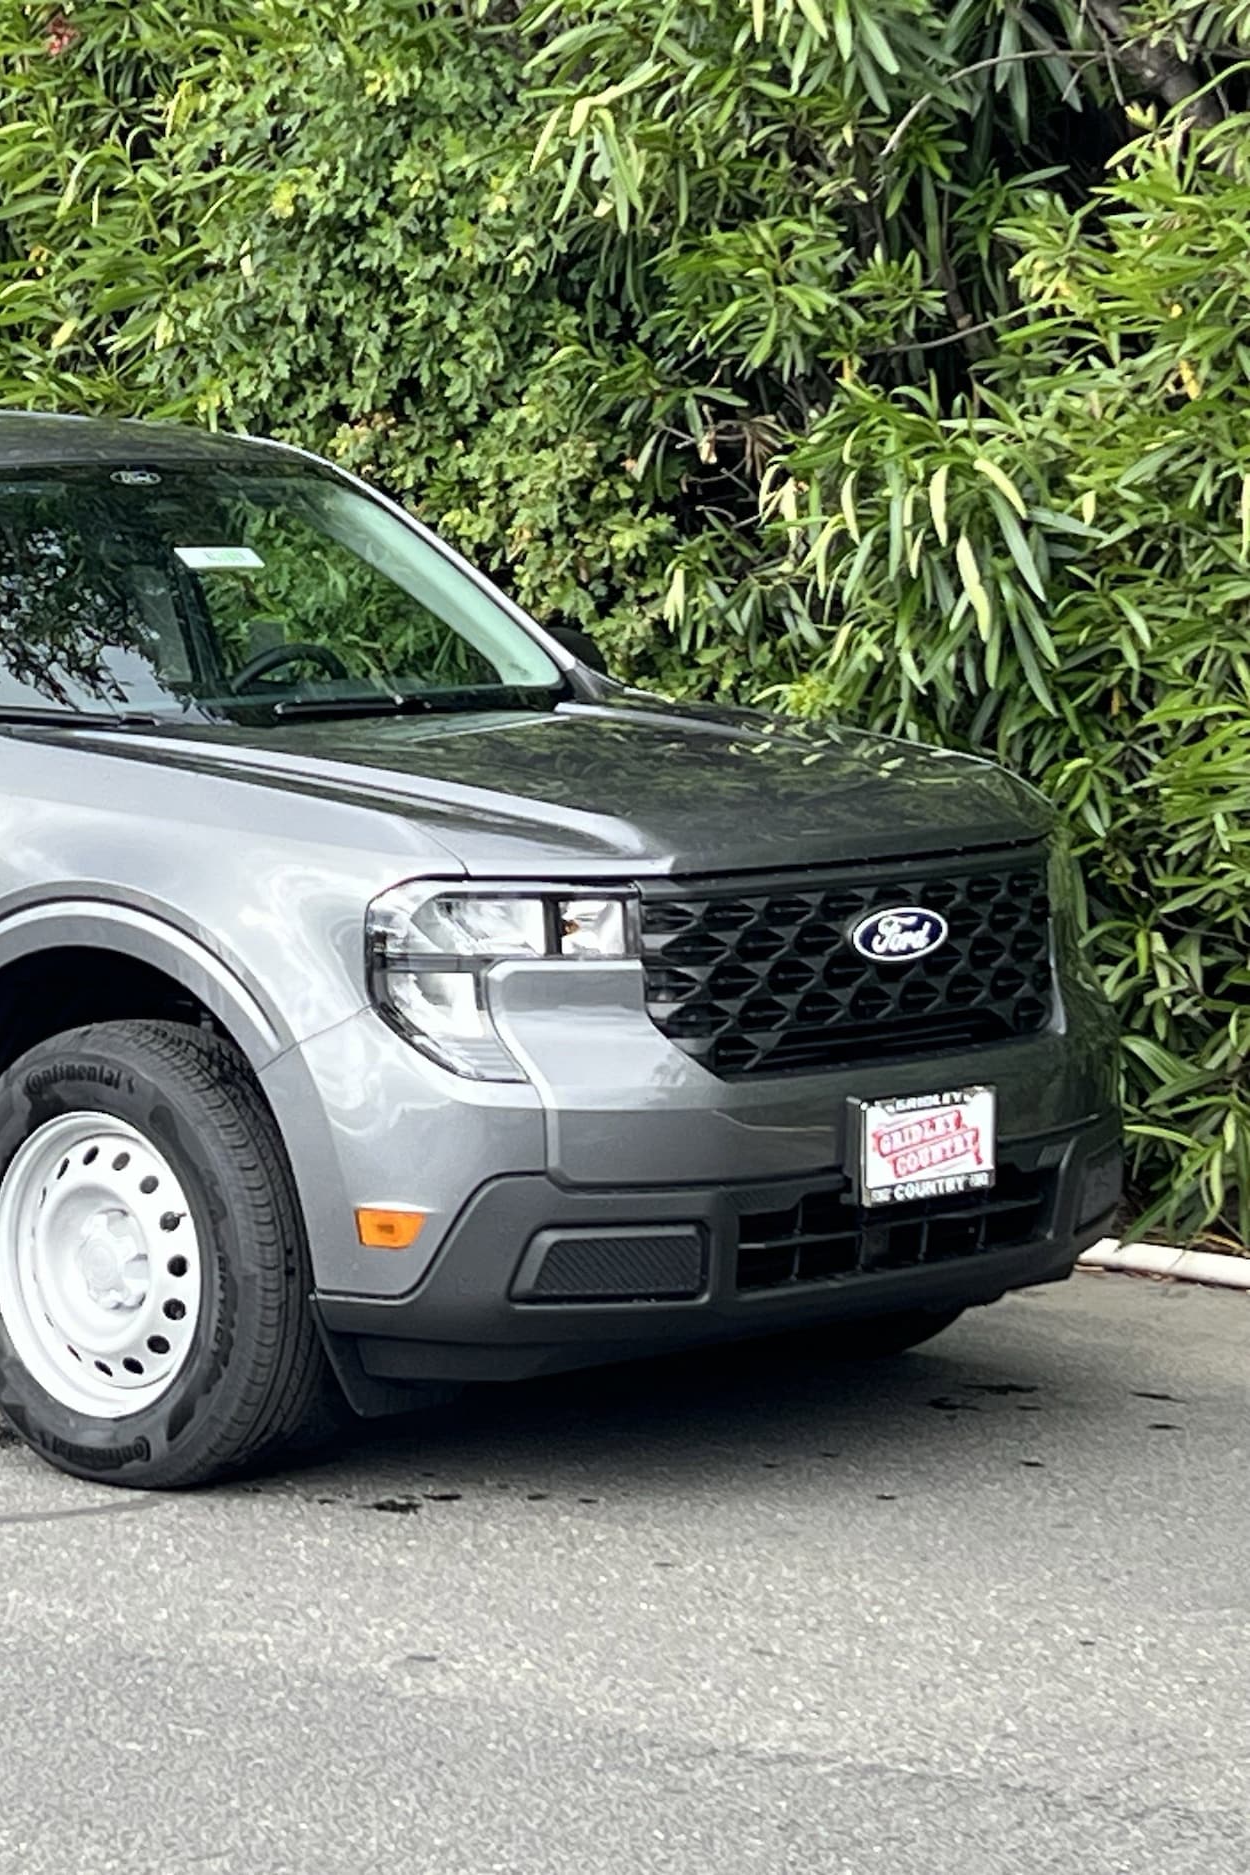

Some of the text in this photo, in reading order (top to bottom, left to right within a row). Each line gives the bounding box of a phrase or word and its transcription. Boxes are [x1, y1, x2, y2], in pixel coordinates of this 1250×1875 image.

[871, 915, 931, 953] Ford
[25, 1063, 122, 1096] Continental
[879, 1113, 958, 1154] GRIDLEY
[895, 1131, 977, 1176] COUNTRY
[894, 1175, 967, 1201] COUNTRY
